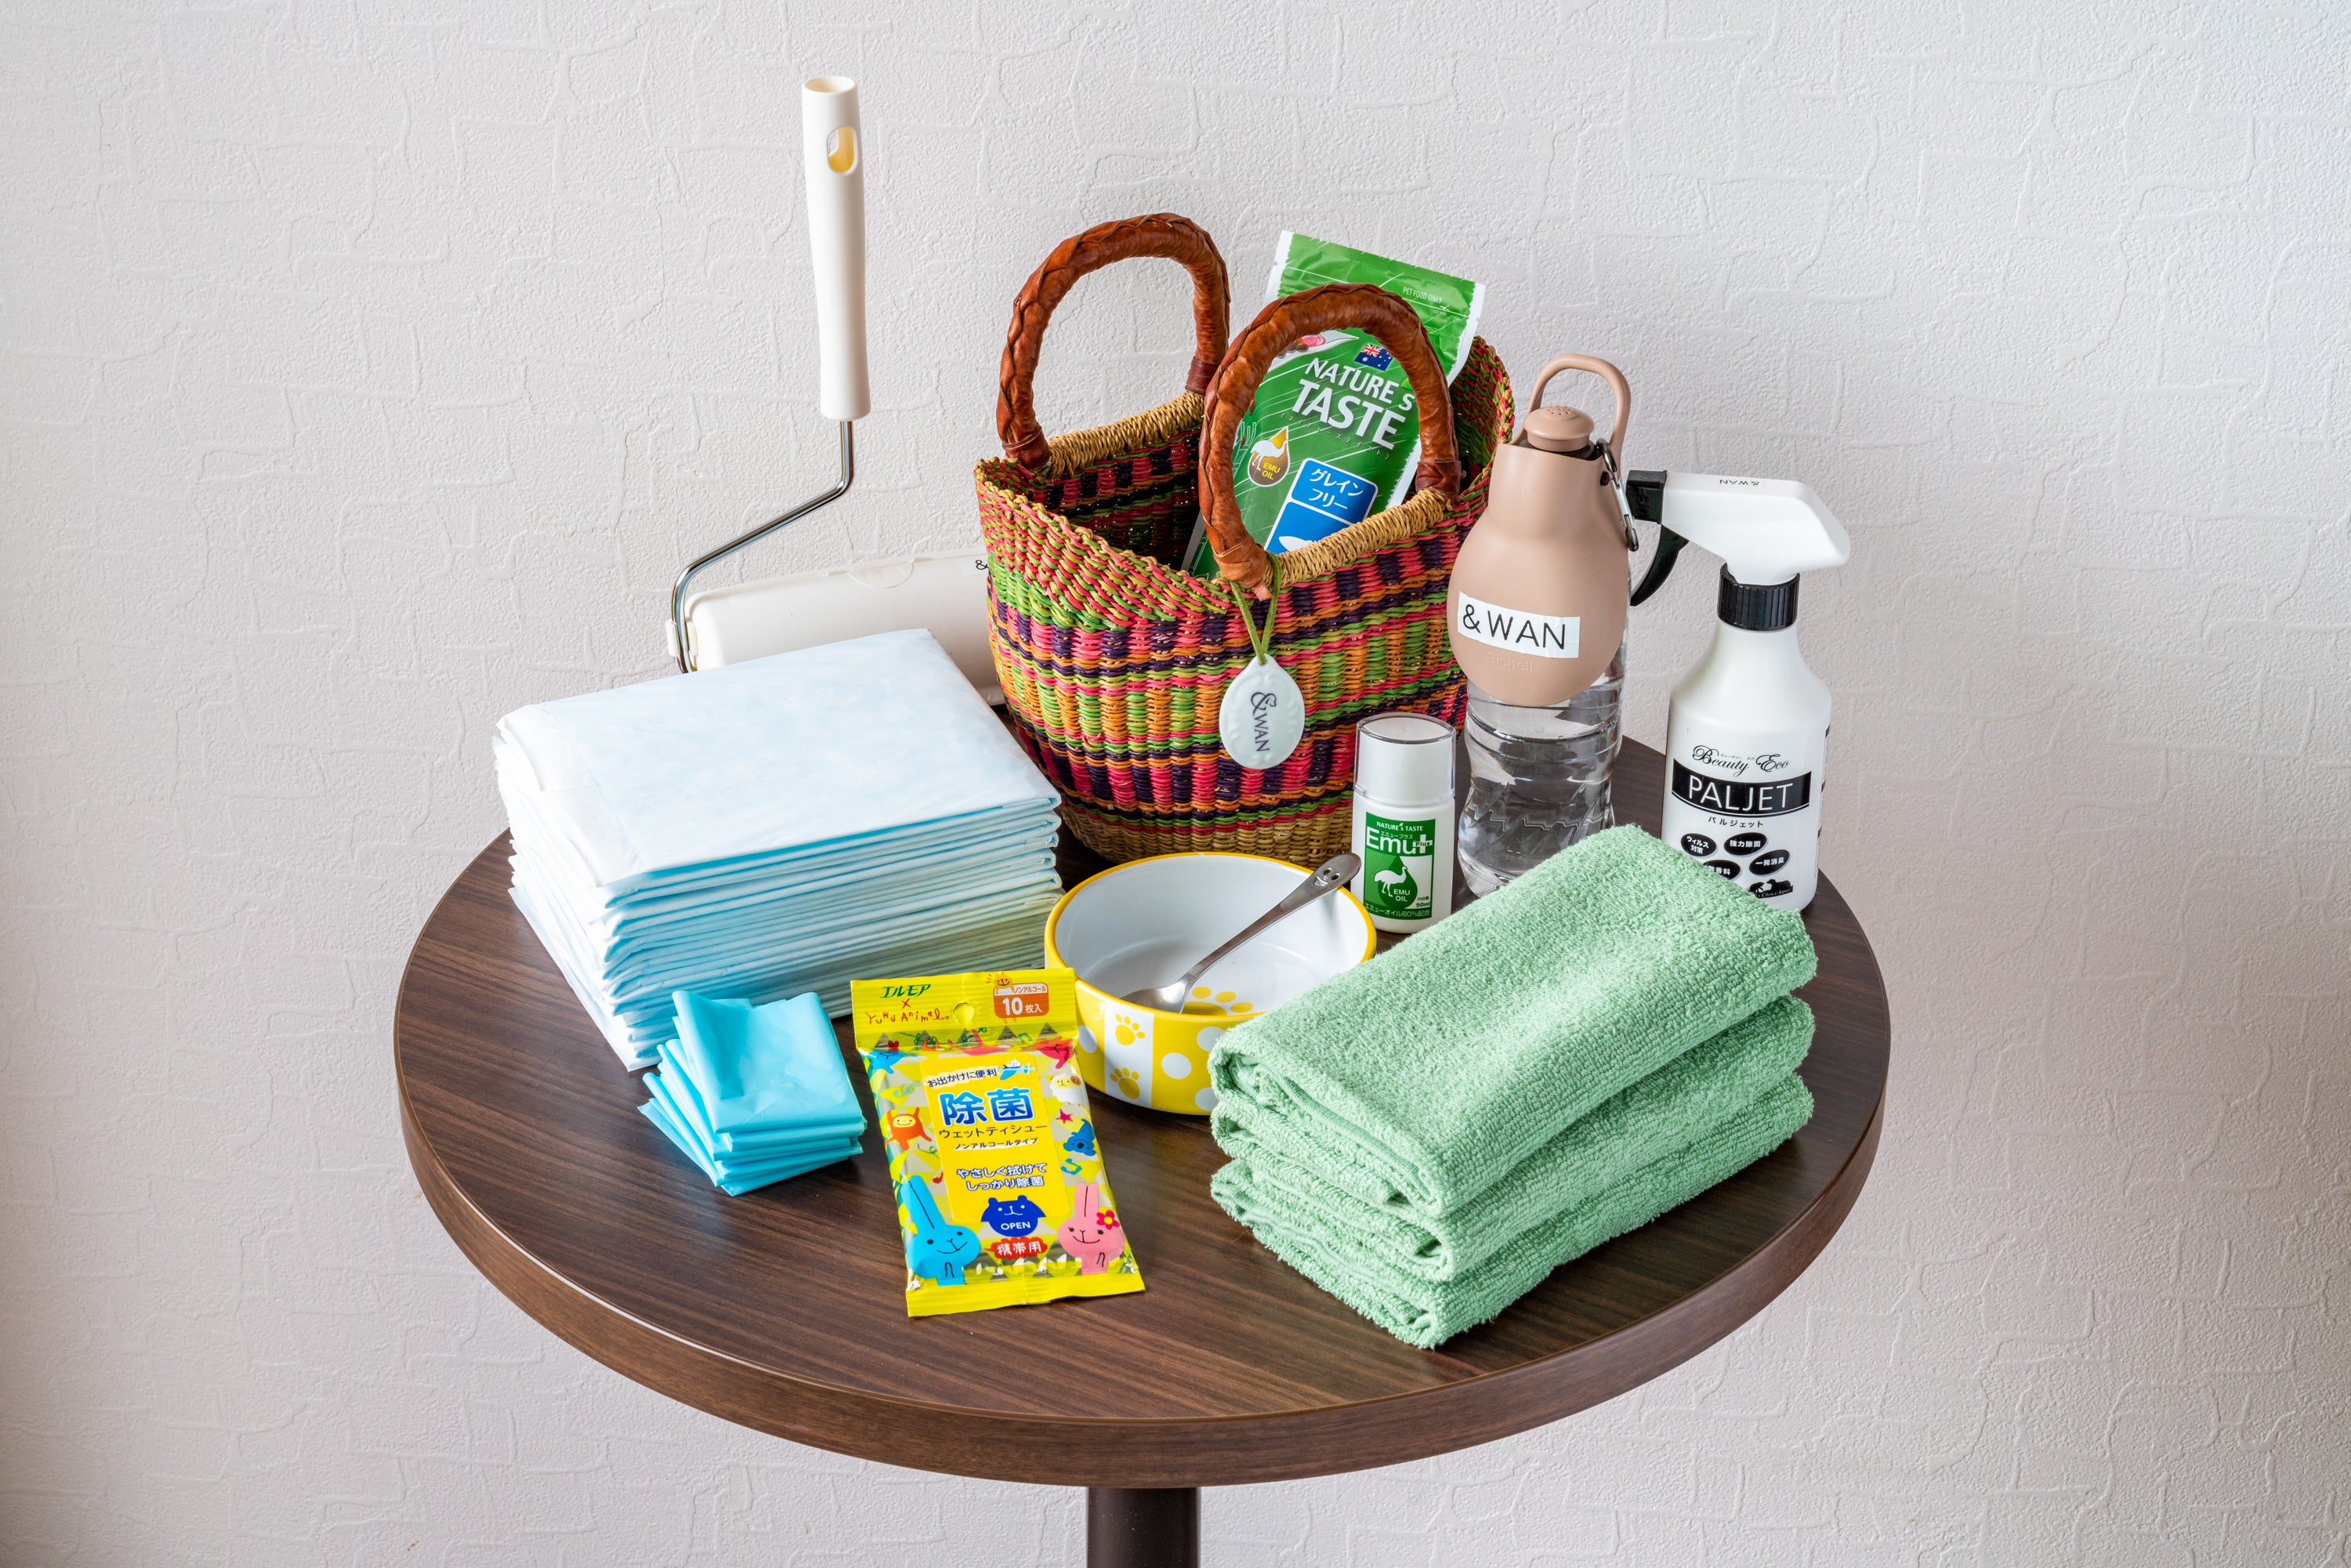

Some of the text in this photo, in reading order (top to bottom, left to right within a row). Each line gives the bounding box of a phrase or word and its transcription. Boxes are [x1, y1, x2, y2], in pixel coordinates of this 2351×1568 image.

[1403, 287, 1443, 303] PET FOOD ONLY
[1291, 379, 1407, 451] TASTE
[1262, 462, 1281, 473] EMU
[1262, 470, 1274, 480] OIL
[1309, 468, 1364, 497] グレイン
[1308, 488, 1348, 509] フリー
[1692, 744, 1790, 777] Beauty Eco
[1688, 774, 1794, 812] PALJET
[879, 983, 932, 999] エルモア
[1014, 985, 1047, 994] ノンアルコール
[926, 1068, 998, 1088] お出かけに便利
[938, 1087, 1034, 1127] 除菌
[938, 1124, 1048, 1139] ウェットティシュー
[955, 1137, 1039, 1150] ノンアルコールタイプ
[956, 1163, 1048, 1179] やさしく拭けて
[965, 1175, 1045, 1191] しっかり除菌
[1000, 1221, 1031, 1231] OPEN
[996, 1240, 1043, 1256] 携帯用
